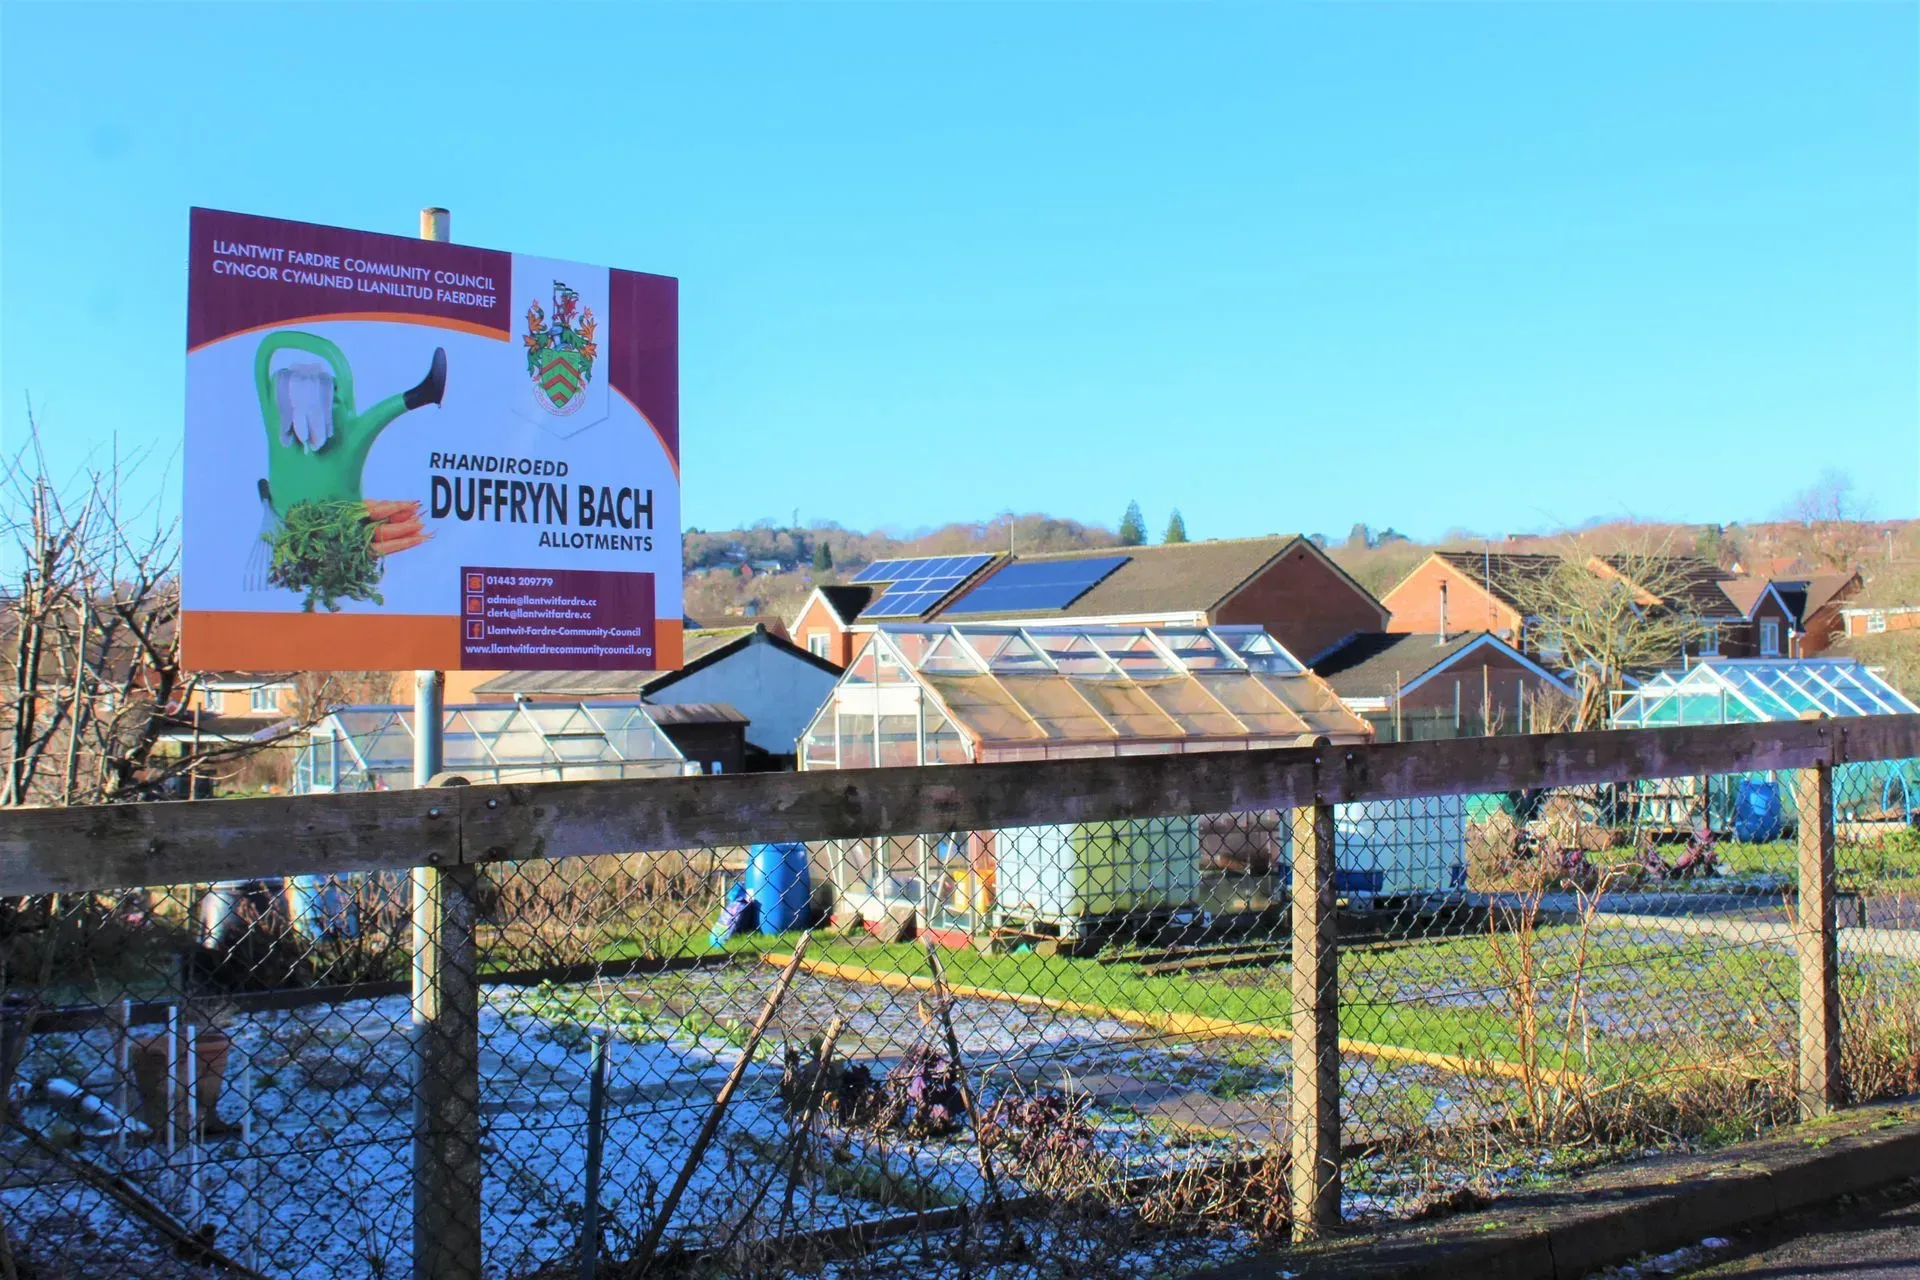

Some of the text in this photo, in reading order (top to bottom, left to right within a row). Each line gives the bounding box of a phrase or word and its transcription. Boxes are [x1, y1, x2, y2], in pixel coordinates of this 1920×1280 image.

[213, 240, 496, 291] LLANTWIT FARDRE COMMUNITY COUNCIL
[212, 260, 497, 308] CYNGOR CYMUNED LLANILLTUD FAERDREF
[429, 452, 569, 477] RHANDIROEDD
[431, 475, 654, 530] DUFFRYN BACH
[538, 531, 653, 552] ALLOTMENTS
[486, 576, 554, 587] 01443 209779
[486, 595, 597, 607] admin@llantwitfardre.cc
[486, 609, 592, 620] clerk@llantwitfardre.cc
[487, 625, 641, 638] Llantwit-Fardre-Community-Council
[465, 643, 652, 657] www.llantwitfardrecommunitycouncil.org
